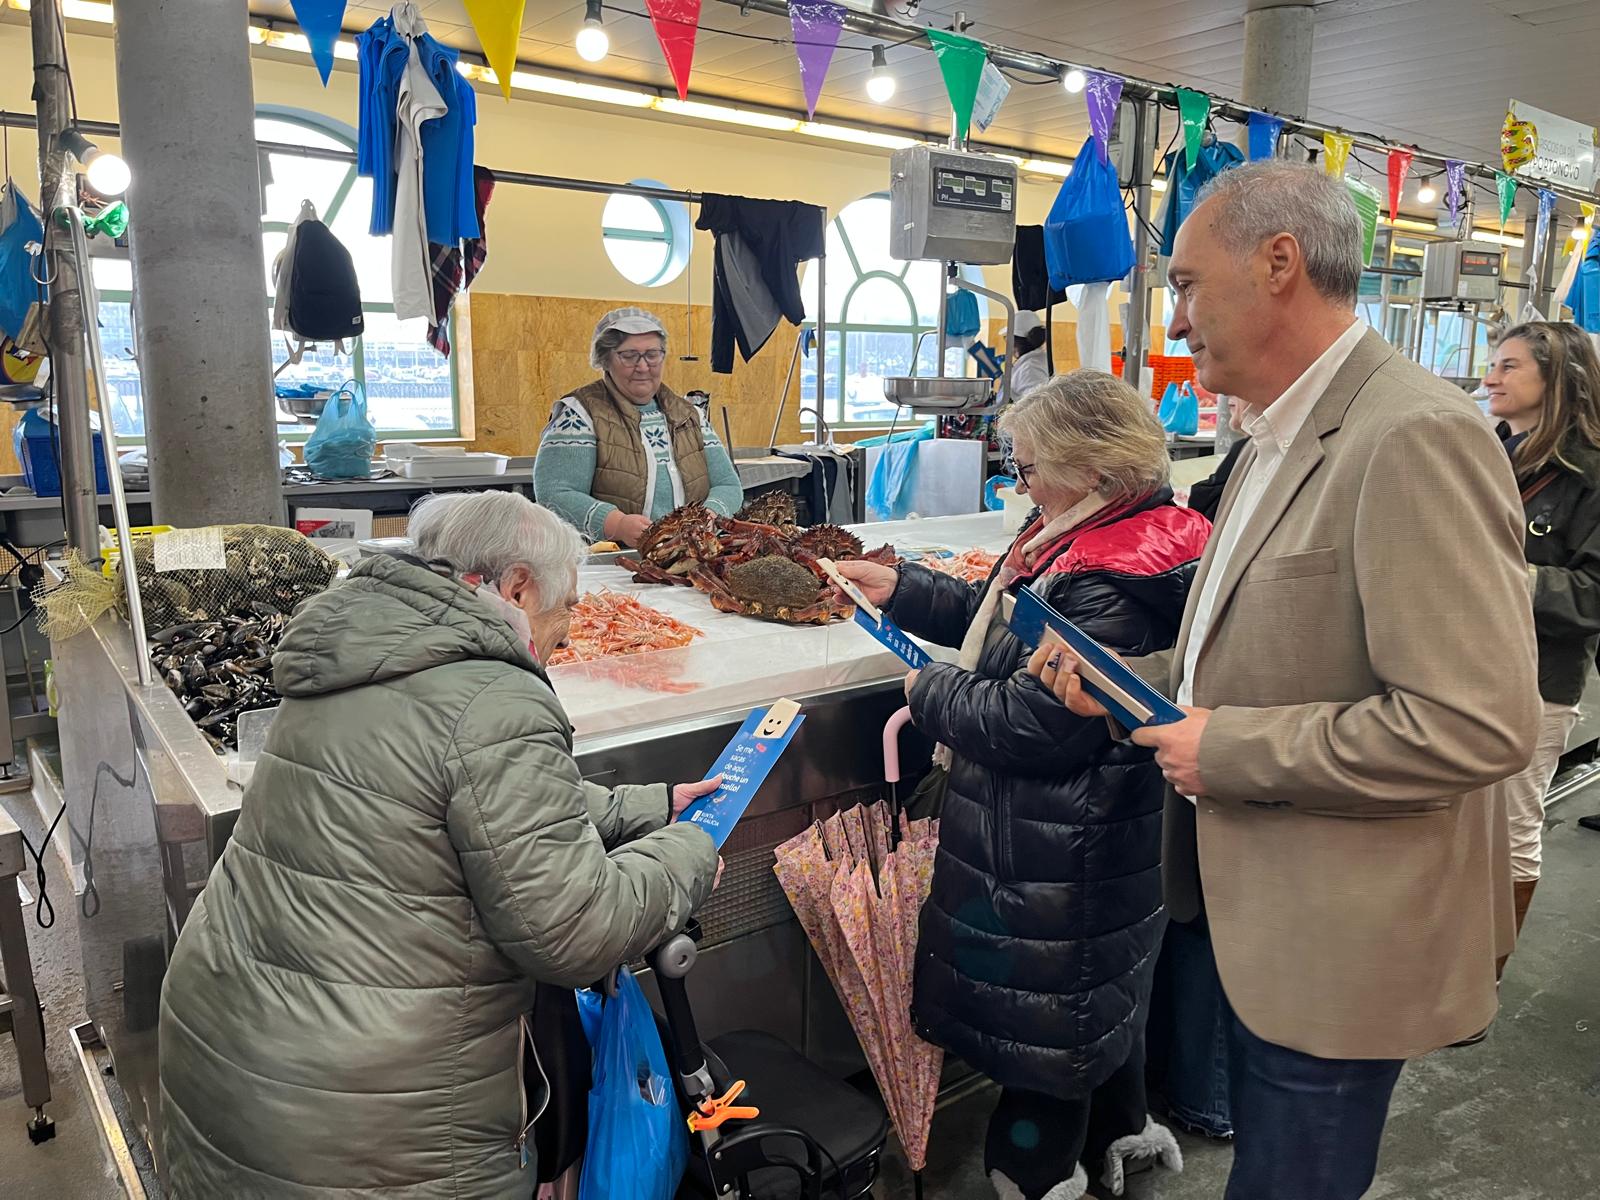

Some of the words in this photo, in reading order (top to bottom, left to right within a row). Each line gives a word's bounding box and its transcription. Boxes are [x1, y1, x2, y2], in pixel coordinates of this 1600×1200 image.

[1533, 156, 1580, 180] PORTONOVO
[735, 744, 744, 753] Se
[743, 746, 754, 754] me
[730, 754, 746, 763] sacas
[724, 763, 732, 771] de
[739, 776, 749, 785] un
[719, 782, 741, 793] nsello!
[703, 816, 720, 827] GALICIA
